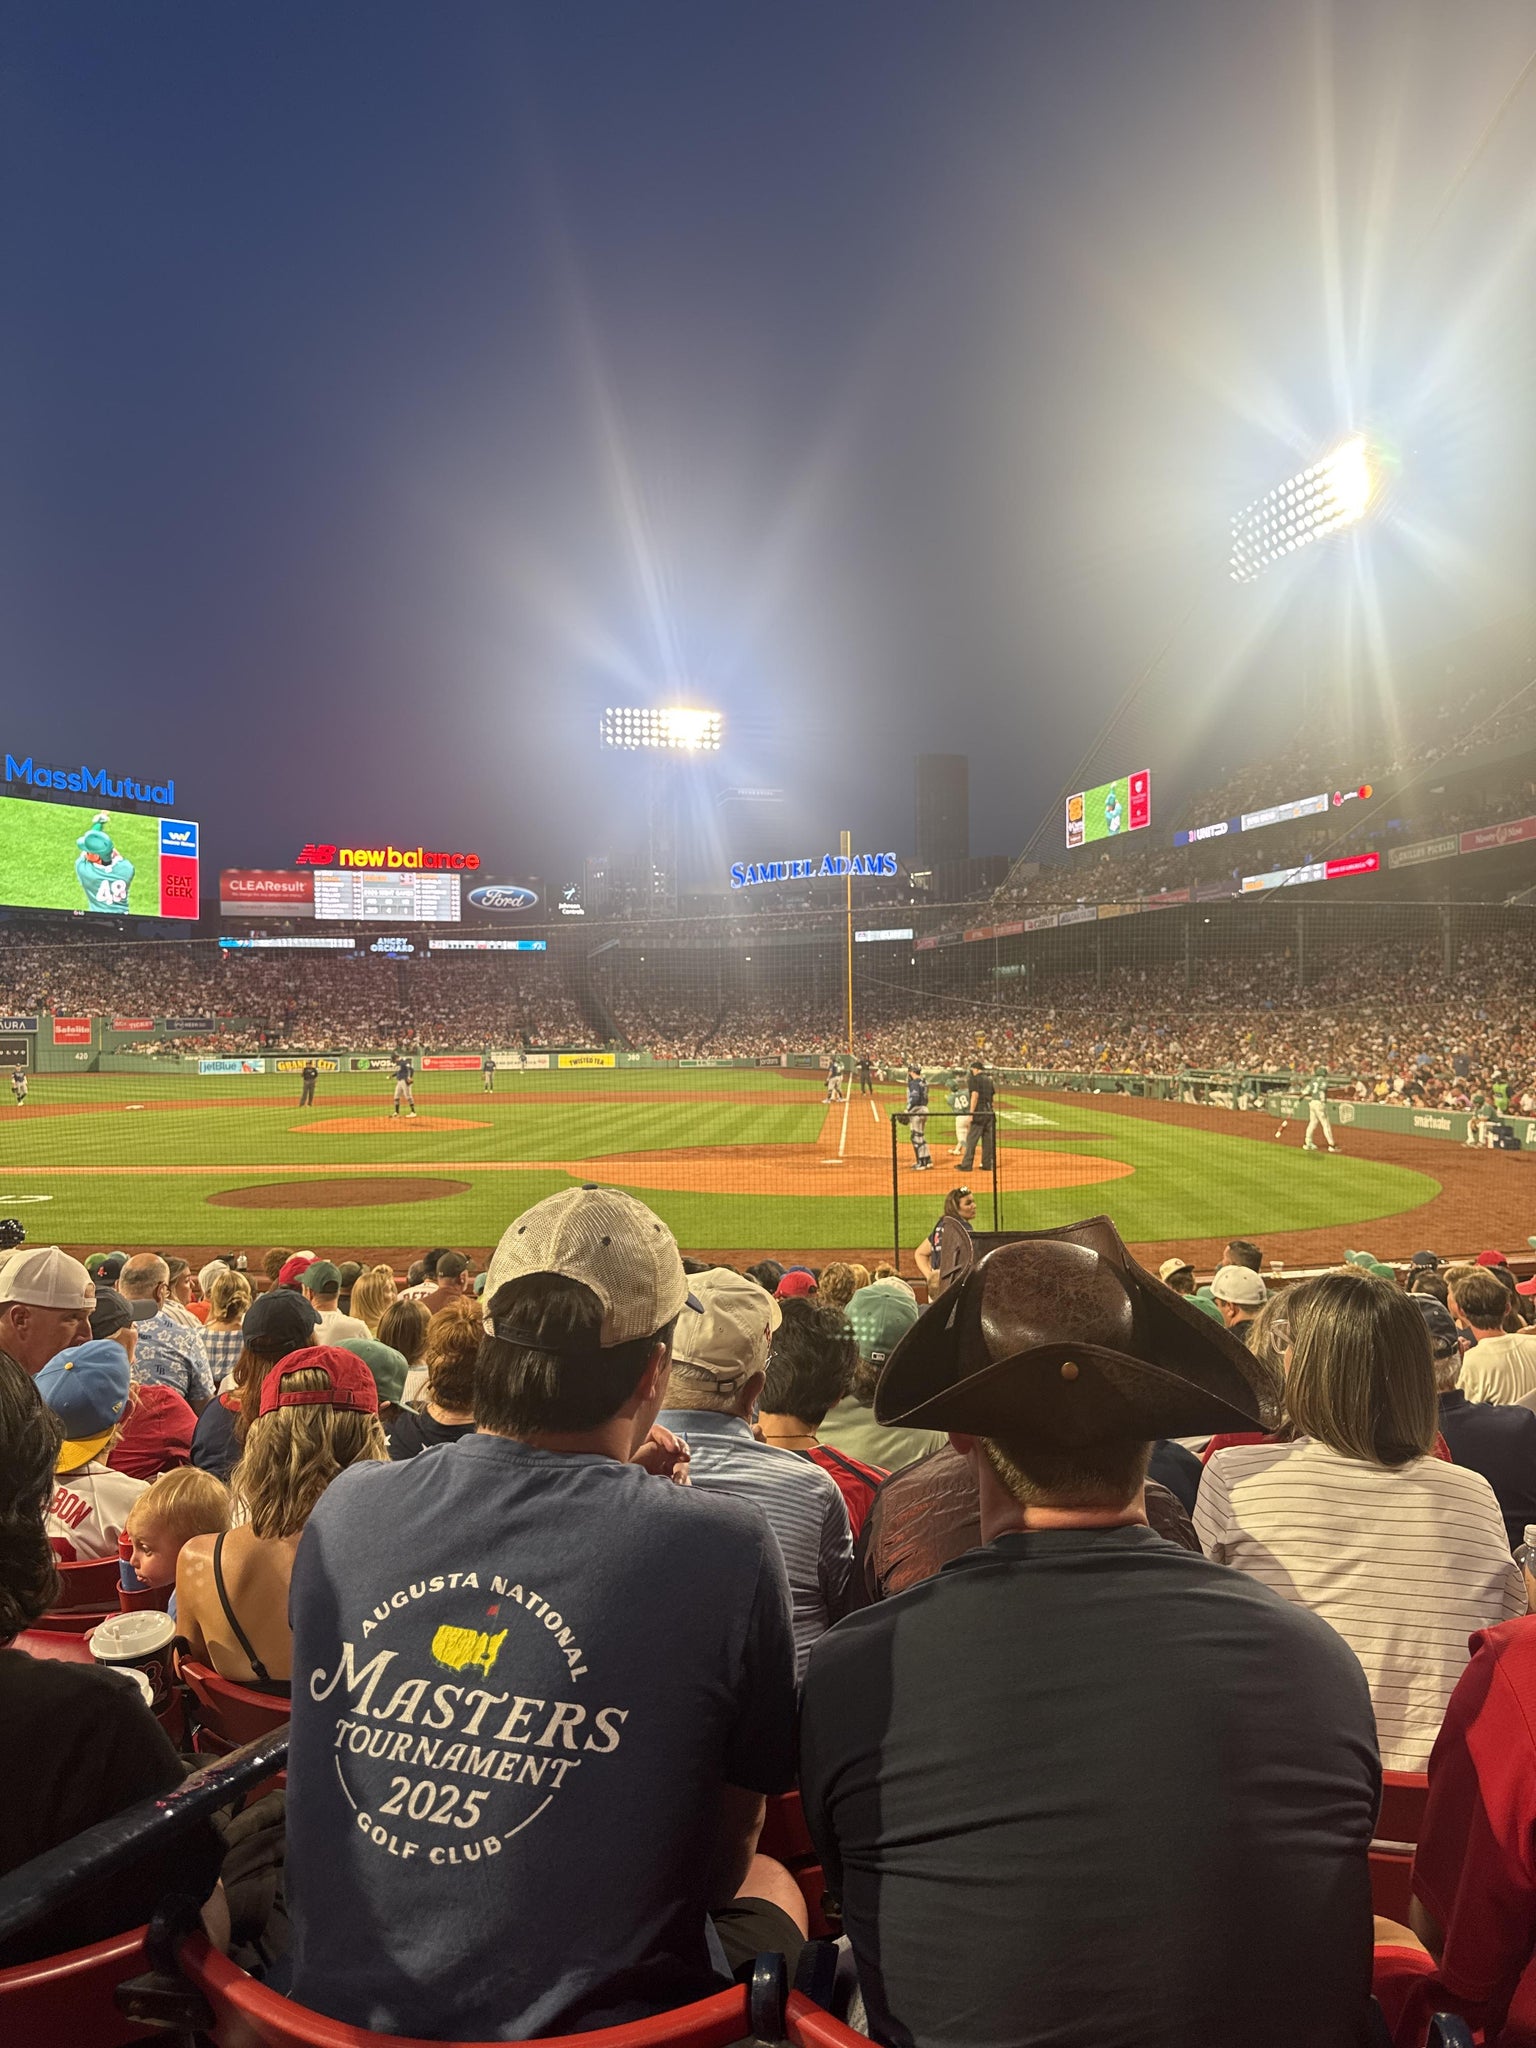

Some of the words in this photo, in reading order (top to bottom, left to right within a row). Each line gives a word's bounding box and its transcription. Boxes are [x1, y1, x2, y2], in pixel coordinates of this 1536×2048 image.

[5, 753, 175, 805] MassMutual
[339, 848, 386, 868] new
[387, 846, 480, 870] balance
[730, 860, 817, 888] SAMUEL
[820, 852, 897, 877] ADAMS
[167, 875, 192, 887] SEAT
[229, 880, 305, 892] CLEAResult
[96, 880, 127, 905] 48
[166, 886, 193, 898] GEEK
[481, 889, 524, 908] Ford
[377, 937, 408, 945] ANGRY
[75, 1052, 89, 1060] 420
[203, 1061, 237, 1072] jetBlue
[954, 1095, 969, 1110] 48
[1414, 1116, 1451, 1131] smartwater
[156, 1365, 166, 1375] TB
[49, 1487, 93, 1530] BON
[361, 1572, 479, 1638] AUGUSTA
[490, 1575, 589, 1683] NATIONAL
[310, 1642, 629, 1753] MASTERS
[334, 1718, 581, 1788] TOURNAMENT
[378, 1776, 490, 1829] 2025
[357, 1812, 420, 1859] GOLF
[429, 1835, 502, 1864] CLUB
